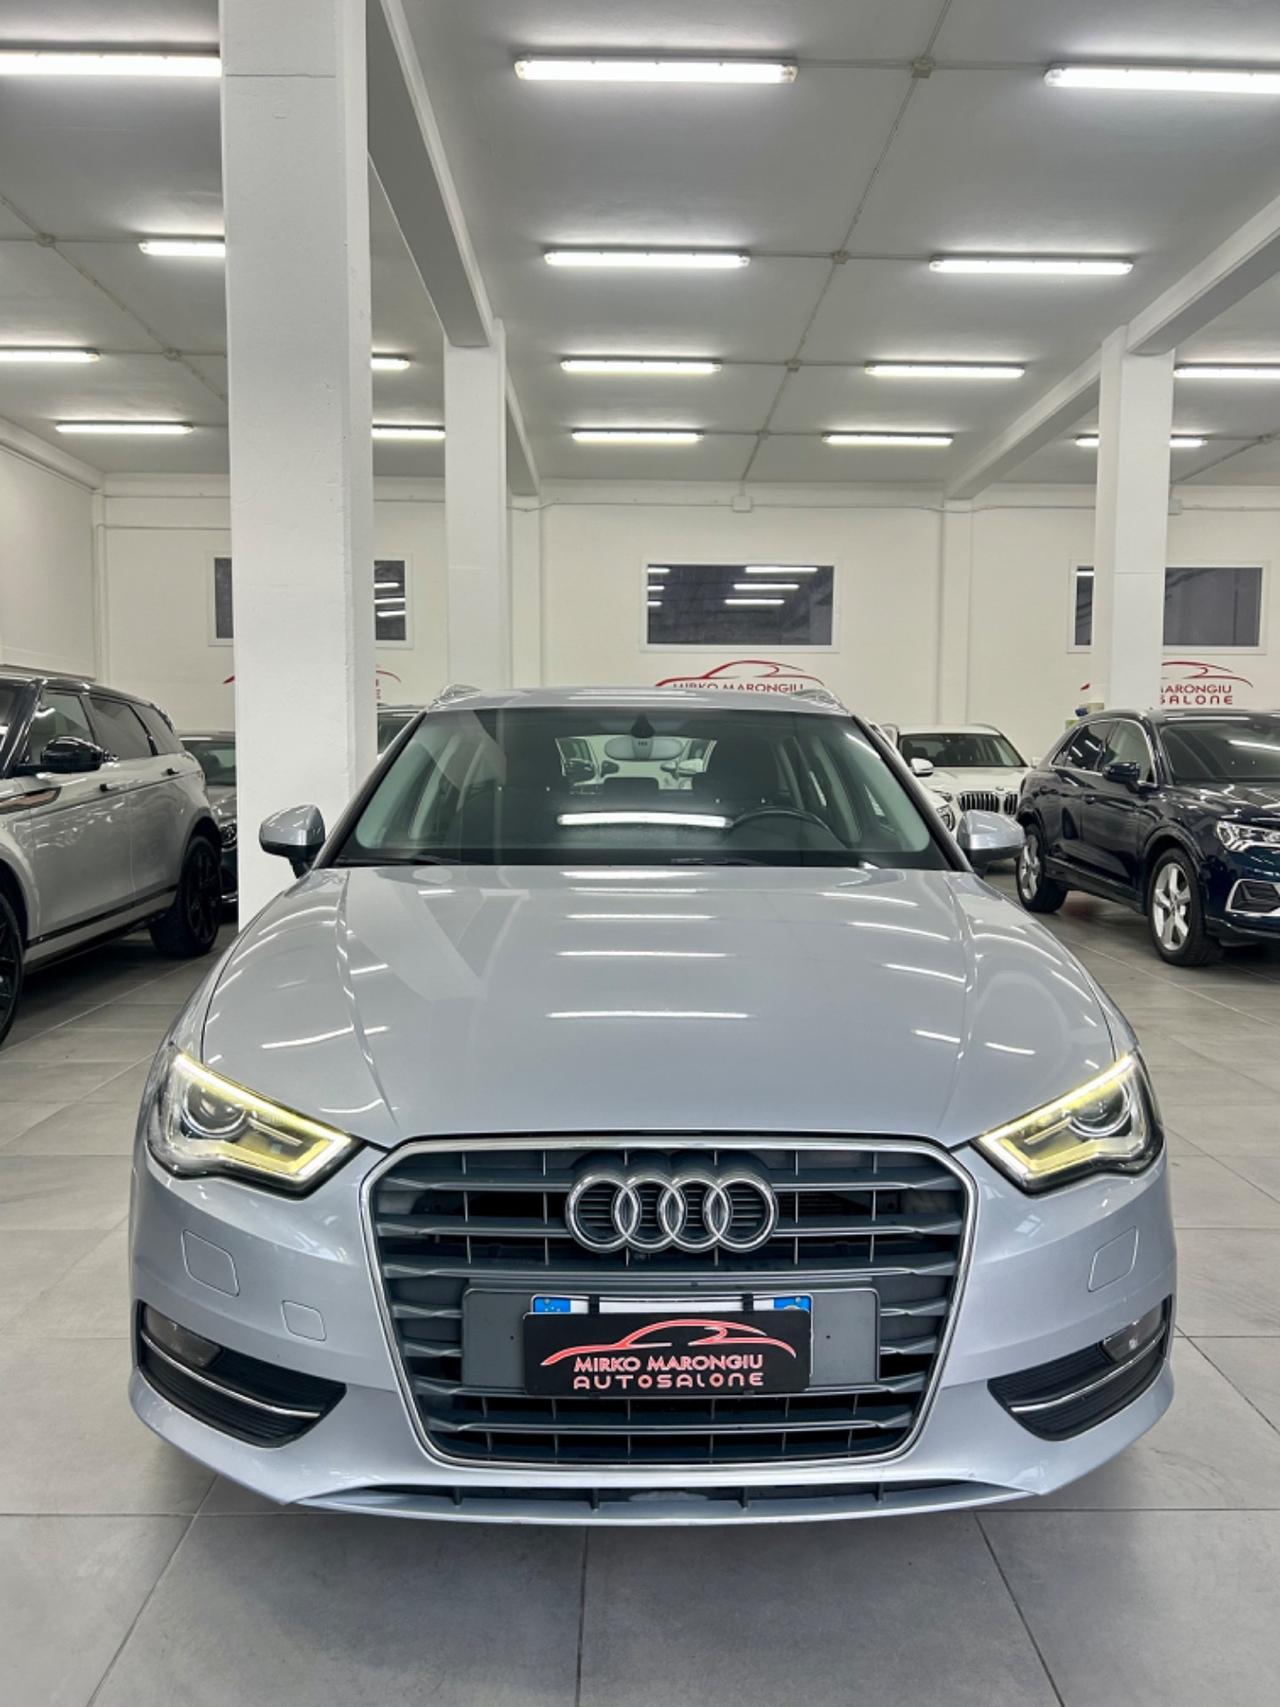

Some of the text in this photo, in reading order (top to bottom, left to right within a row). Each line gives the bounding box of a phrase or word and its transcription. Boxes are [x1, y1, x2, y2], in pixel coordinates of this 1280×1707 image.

[1161, 684, 1232, 694] ARONGIU
[573, 1353, 764, 1373] MIRKO MARONGIU
[573, 1372, 764, 1390] AUTOSALONE
